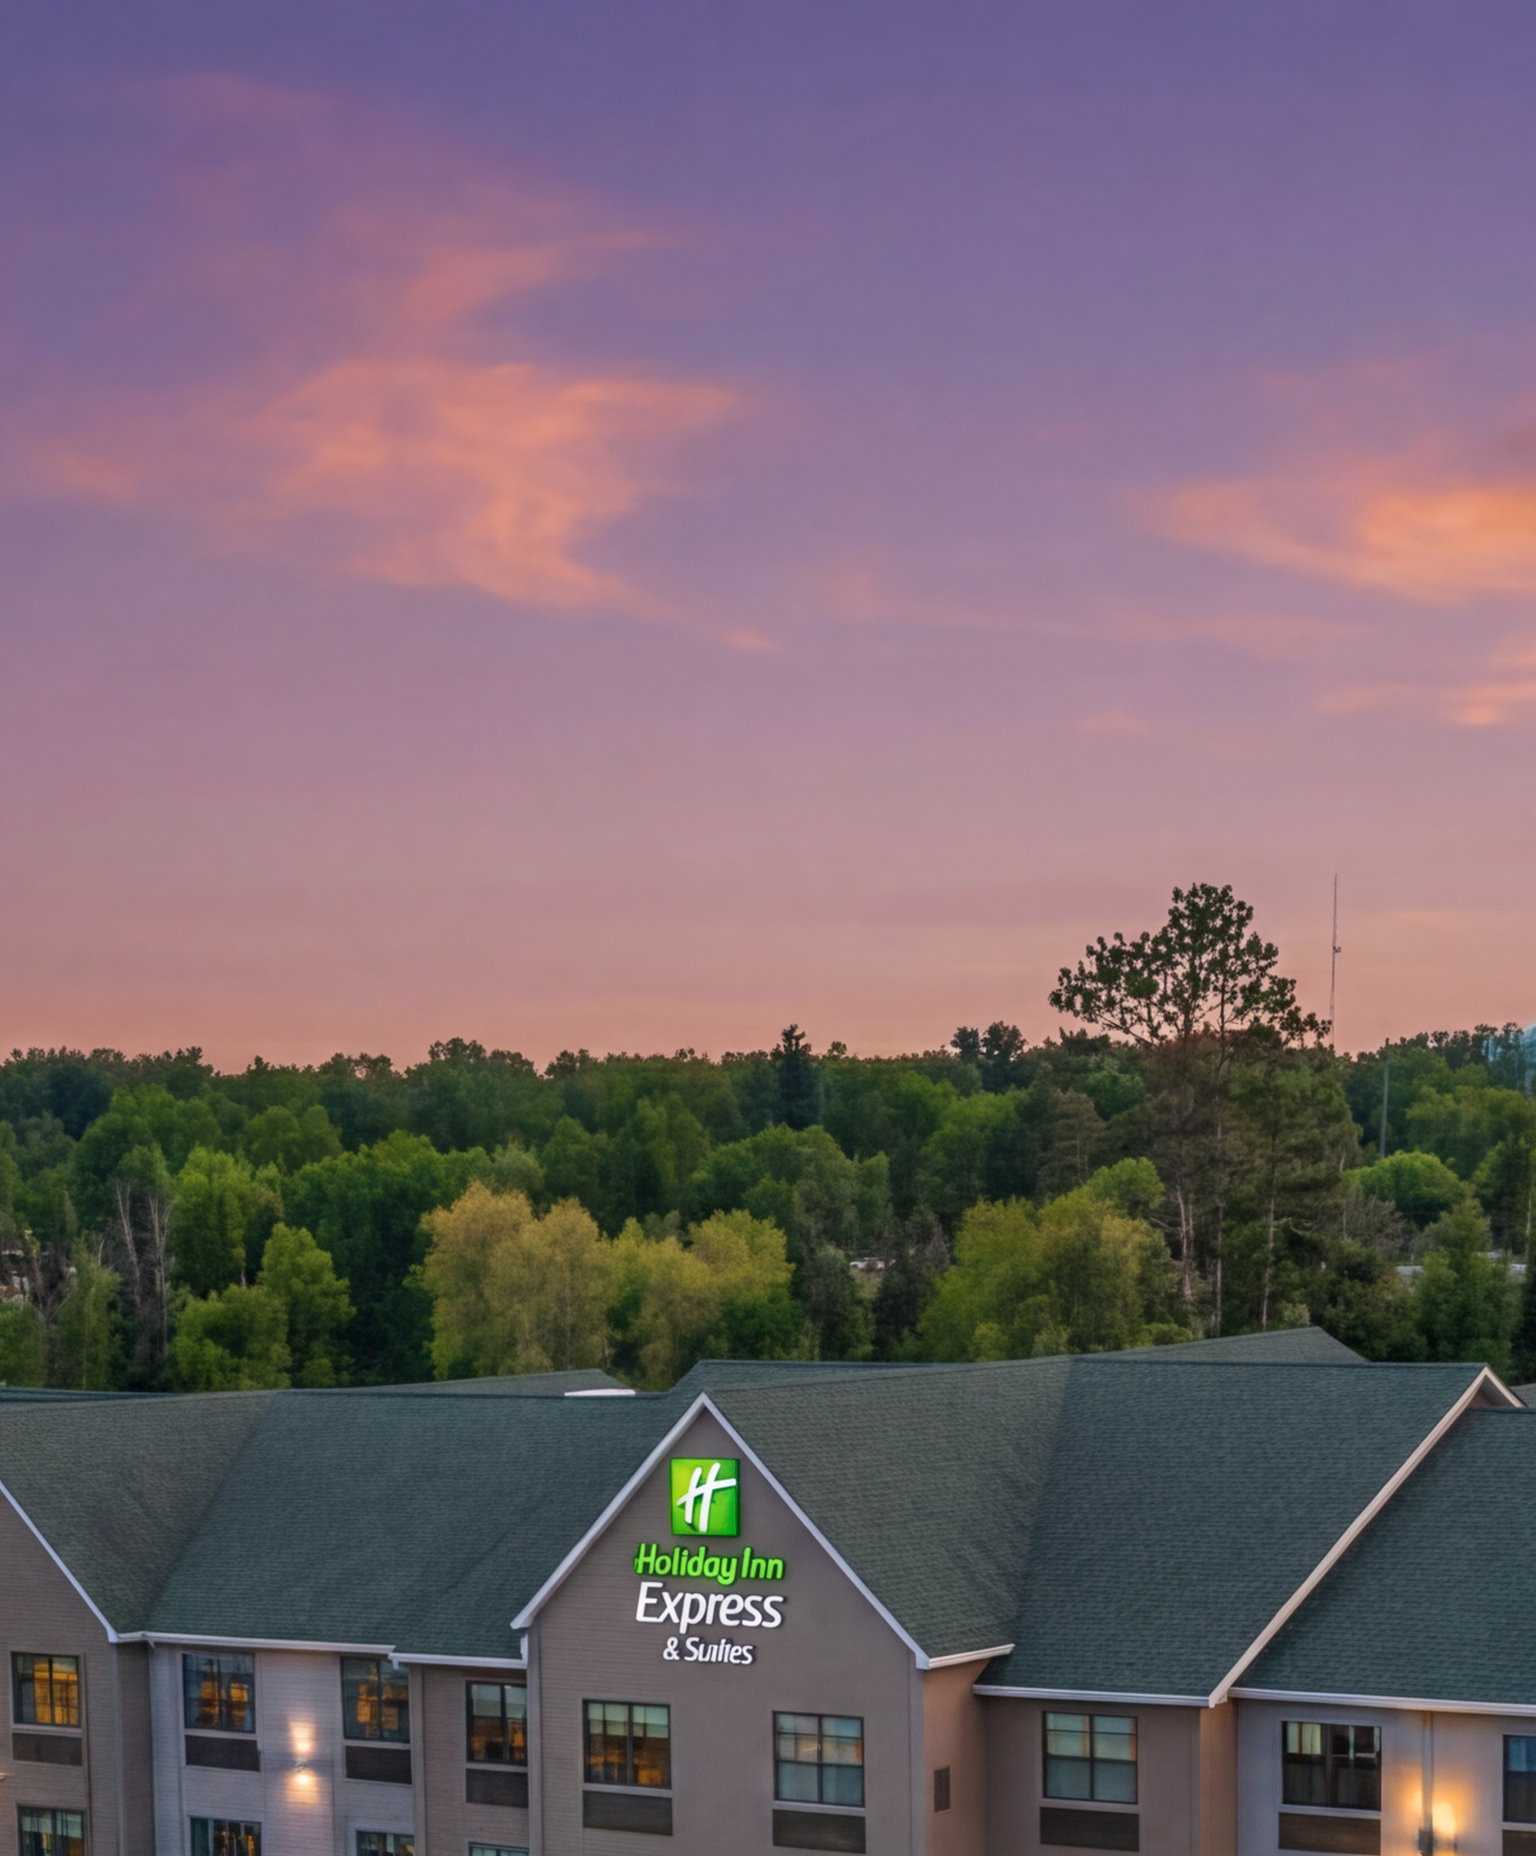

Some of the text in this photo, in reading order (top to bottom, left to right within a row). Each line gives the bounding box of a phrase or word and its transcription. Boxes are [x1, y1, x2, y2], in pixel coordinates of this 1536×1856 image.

[634, 1543, 785, 1586] Holiday Inn
[635, 1581, 784, 1634] Express
[663, 1636, 754, 1665] & Suites
